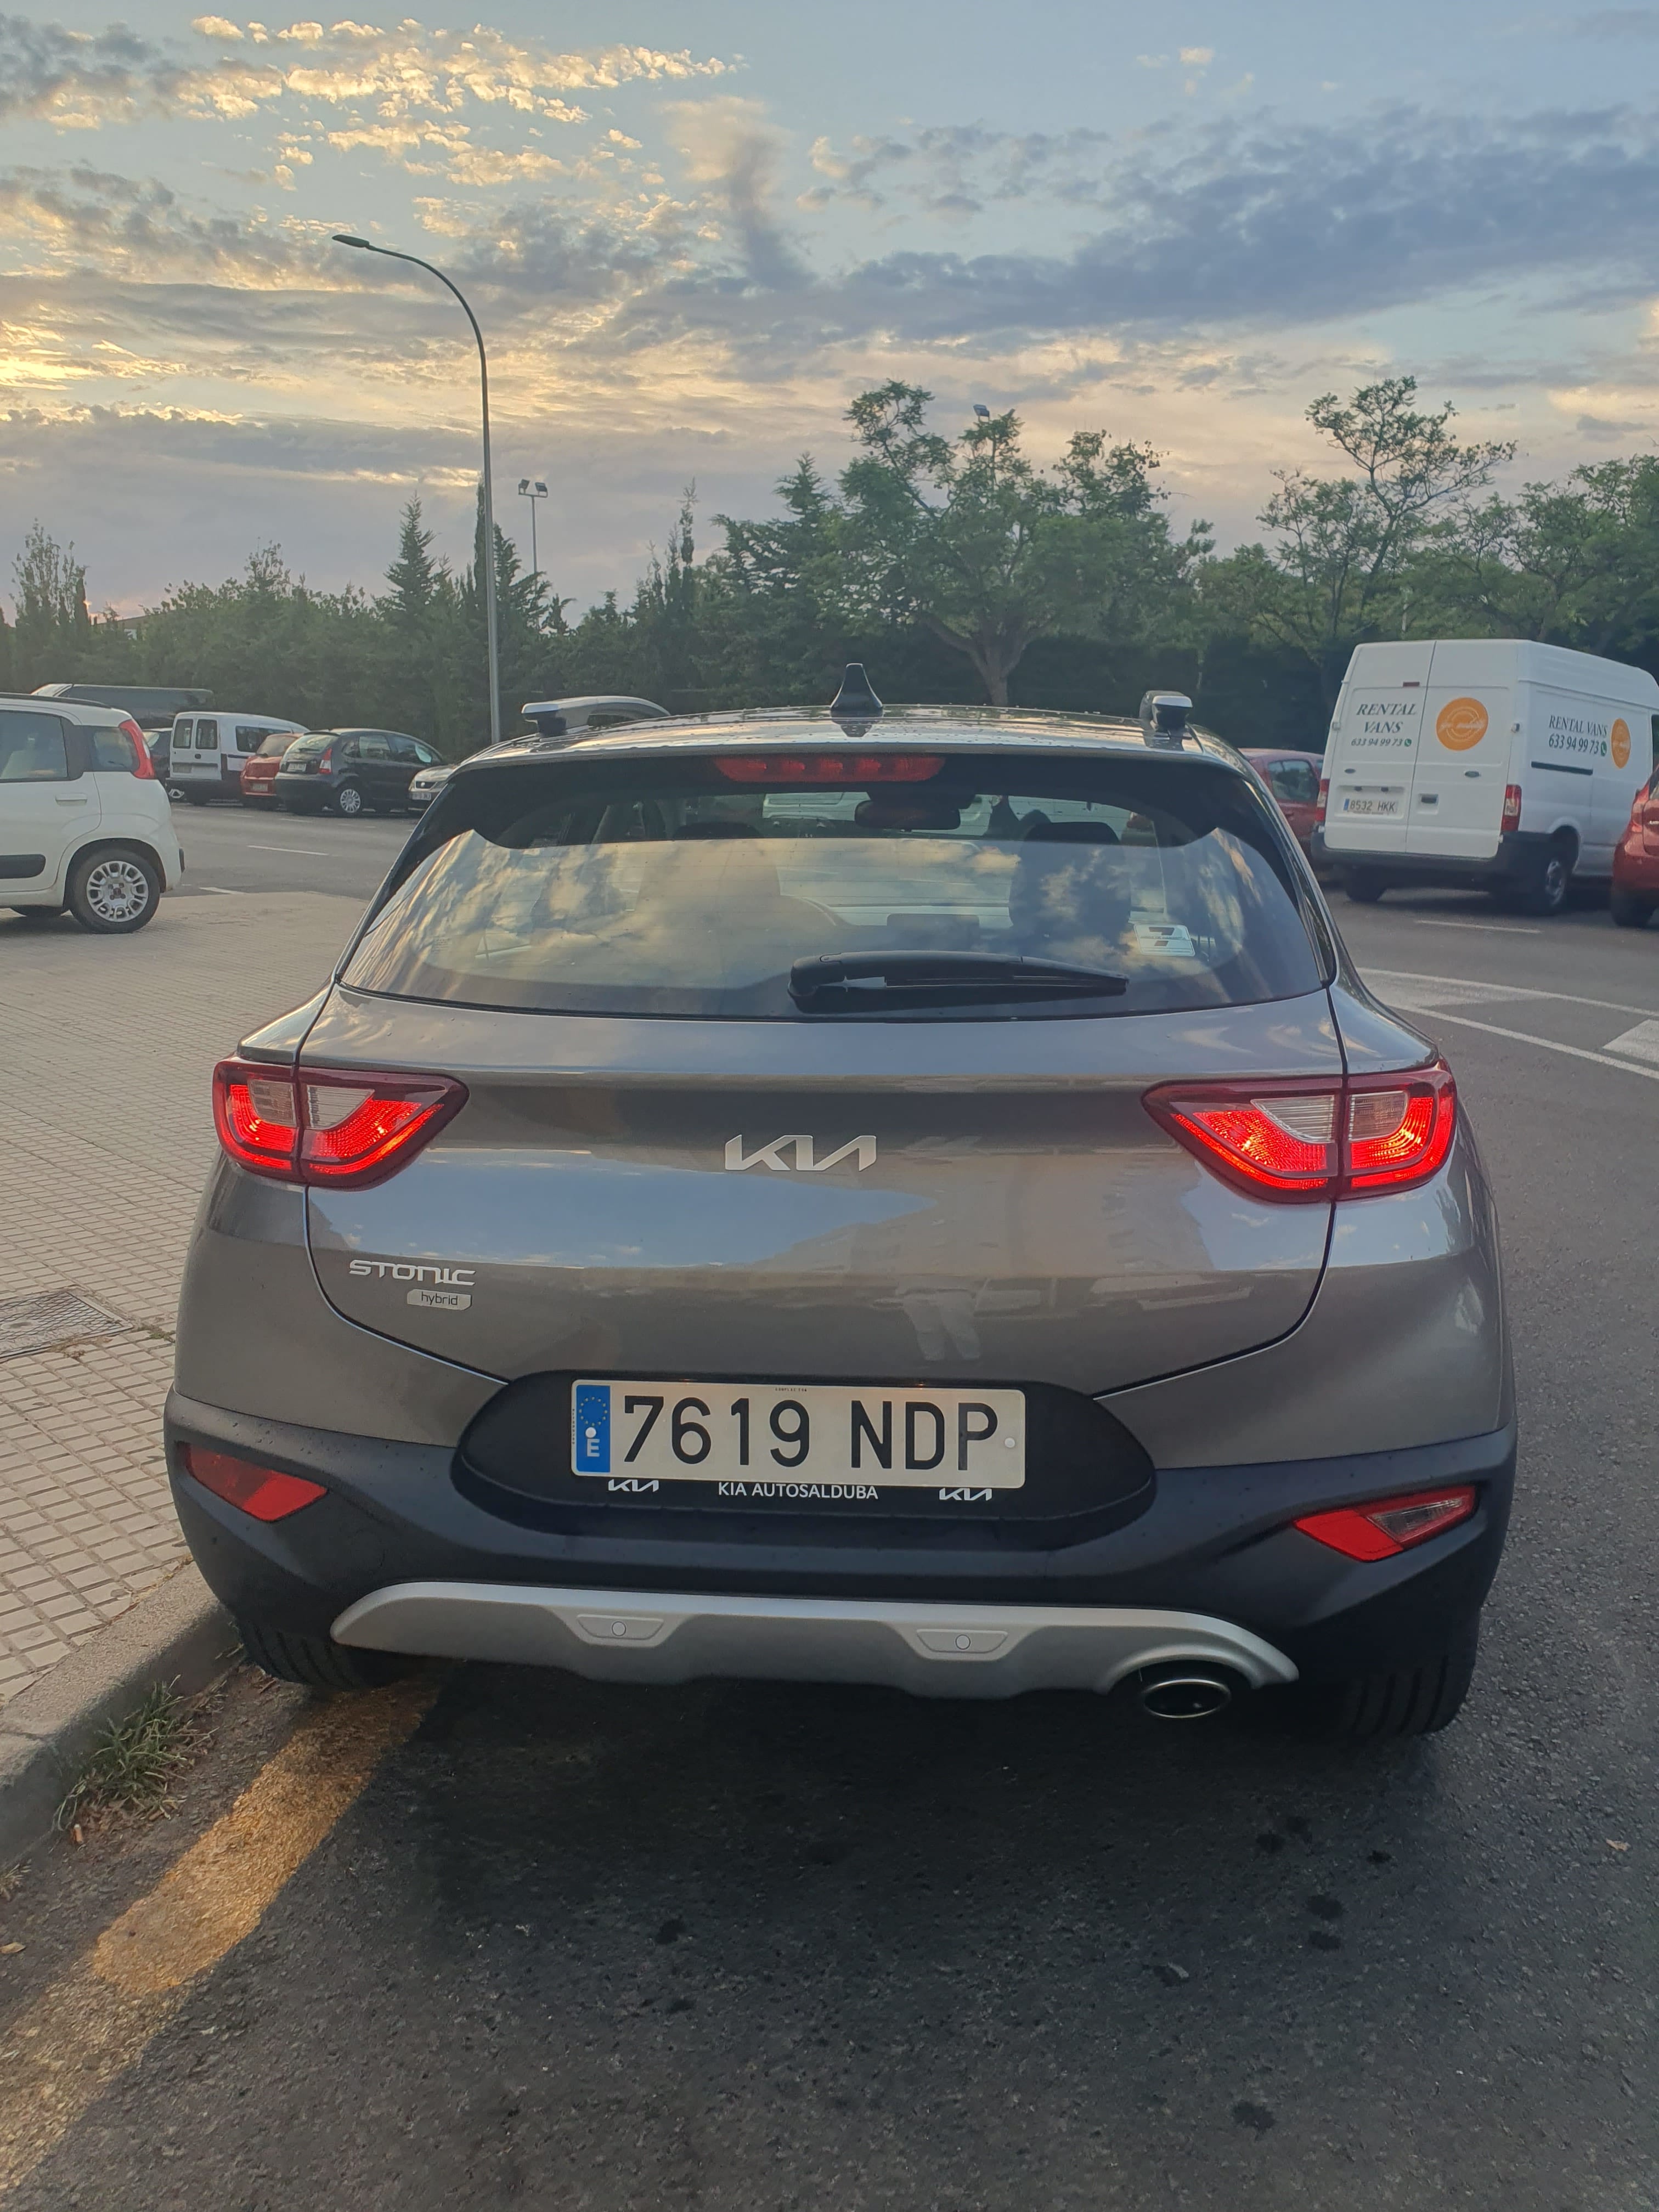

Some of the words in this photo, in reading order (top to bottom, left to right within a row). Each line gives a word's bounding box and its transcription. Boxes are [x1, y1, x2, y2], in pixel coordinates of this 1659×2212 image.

[1356, 703, 1417, 715] RENTAL
[1364, 721, 1403, 733] VANS
[1549, 715, 1584, 733] RENTAL
[1588, 721, 1608, 738] VANS
[1549, 733, 1565, 749] 633
[1566, 736, 1577, 751] 94
[1578, 737, 1588, 752] 99
[1589, 739, 1599, 754] 73
[1350, 800, 1373, 810] 8532
[1378, 800, 1396, 812] HKK
[725, 1134, 877, 1172] KIA
[349, 1259, 476, 1286] STONIC
[421, 1291, 458, 1306] hybrid
[624, 1395, 810, 1468] 7619
[851, 1400, 998, 1471] NDP
[587, 1438, 600, 1457] E
[608, 1479, 659, 1492] KIA
[718, 1482, 747, 1496] KIA
[752, 1483, 878, 1499] AUTOSALDUBA
[939, 1487, 992, 1502] KIA
